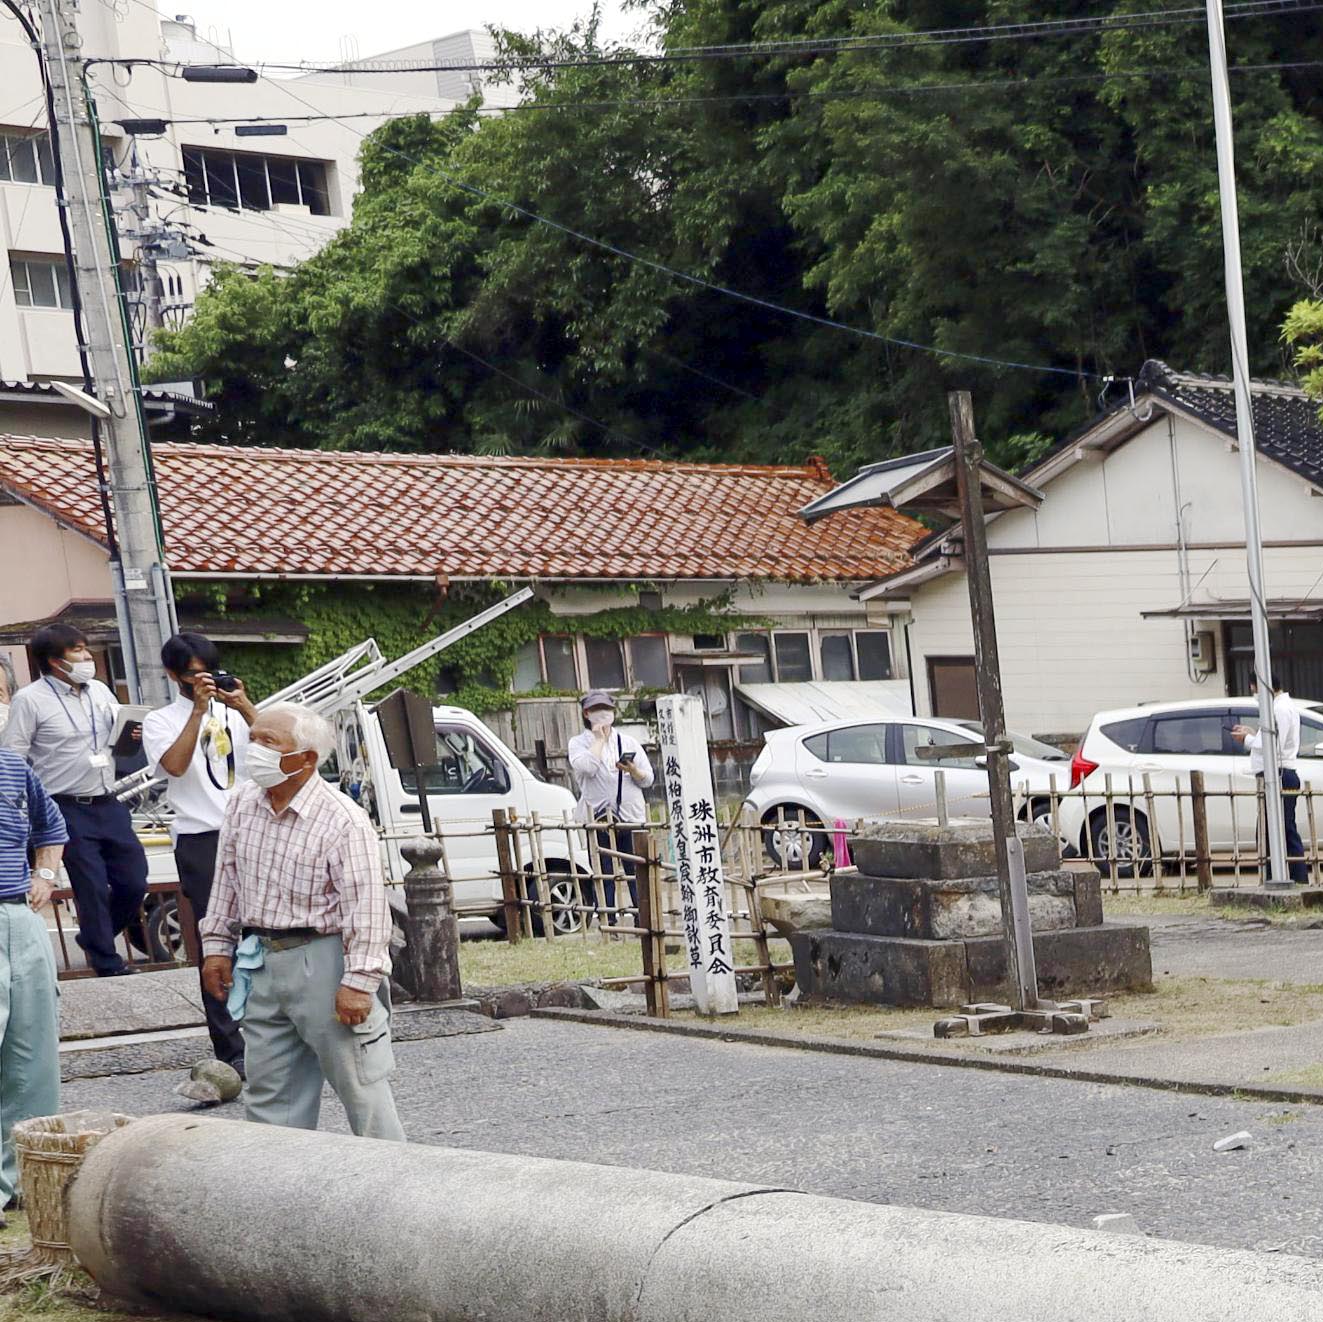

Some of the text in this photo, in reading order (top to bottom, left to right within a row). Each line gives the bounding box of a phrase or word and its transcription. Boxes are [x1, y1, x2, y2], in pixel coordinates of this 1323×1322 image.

[688, 798, 733, 975] 珠洲市教育委員会
